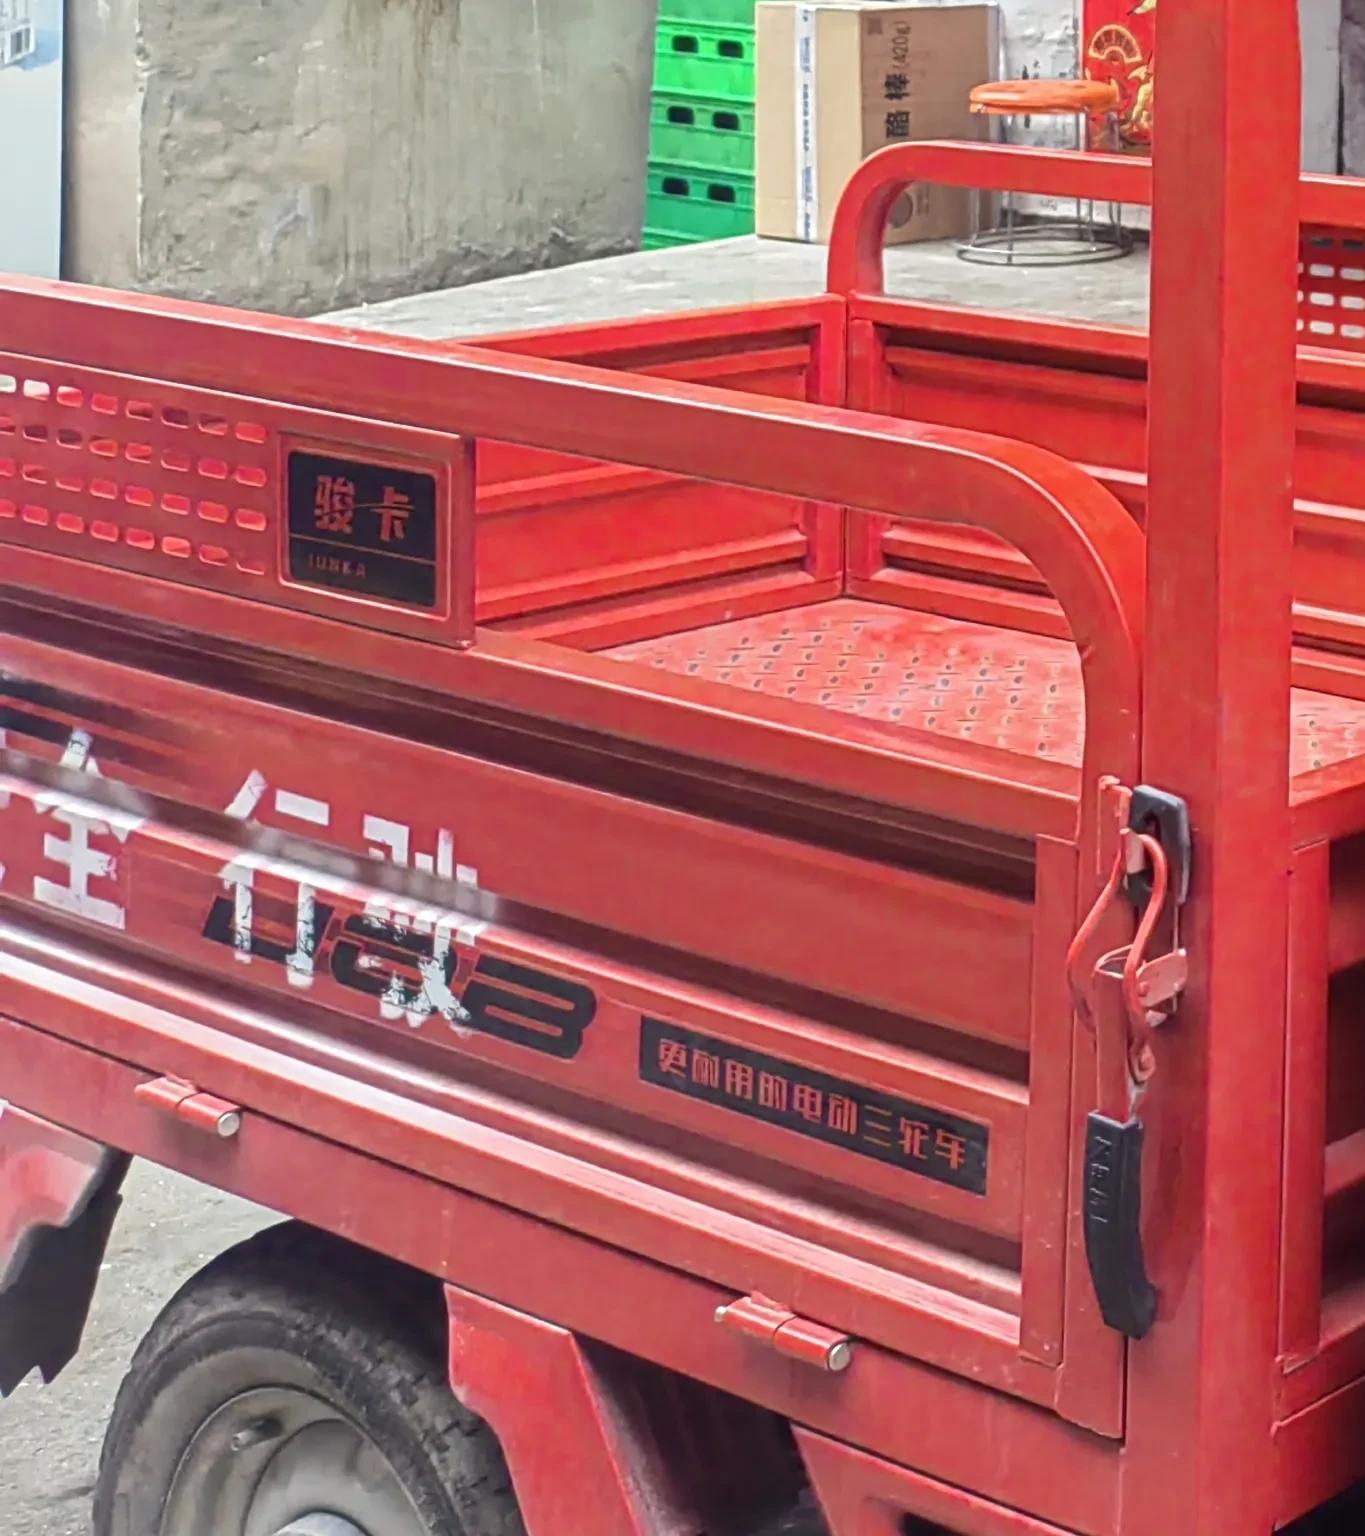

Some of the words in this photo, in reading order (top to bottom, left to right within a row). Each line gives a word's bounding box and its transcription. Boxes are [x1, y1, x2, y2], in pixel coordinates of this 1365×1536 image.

[314, 474, 415, 542] 骏卡
[0, 728, 490, 1037] 全行驶
[657, 1037, 967, 1170] 更耐用的电动三轮车
